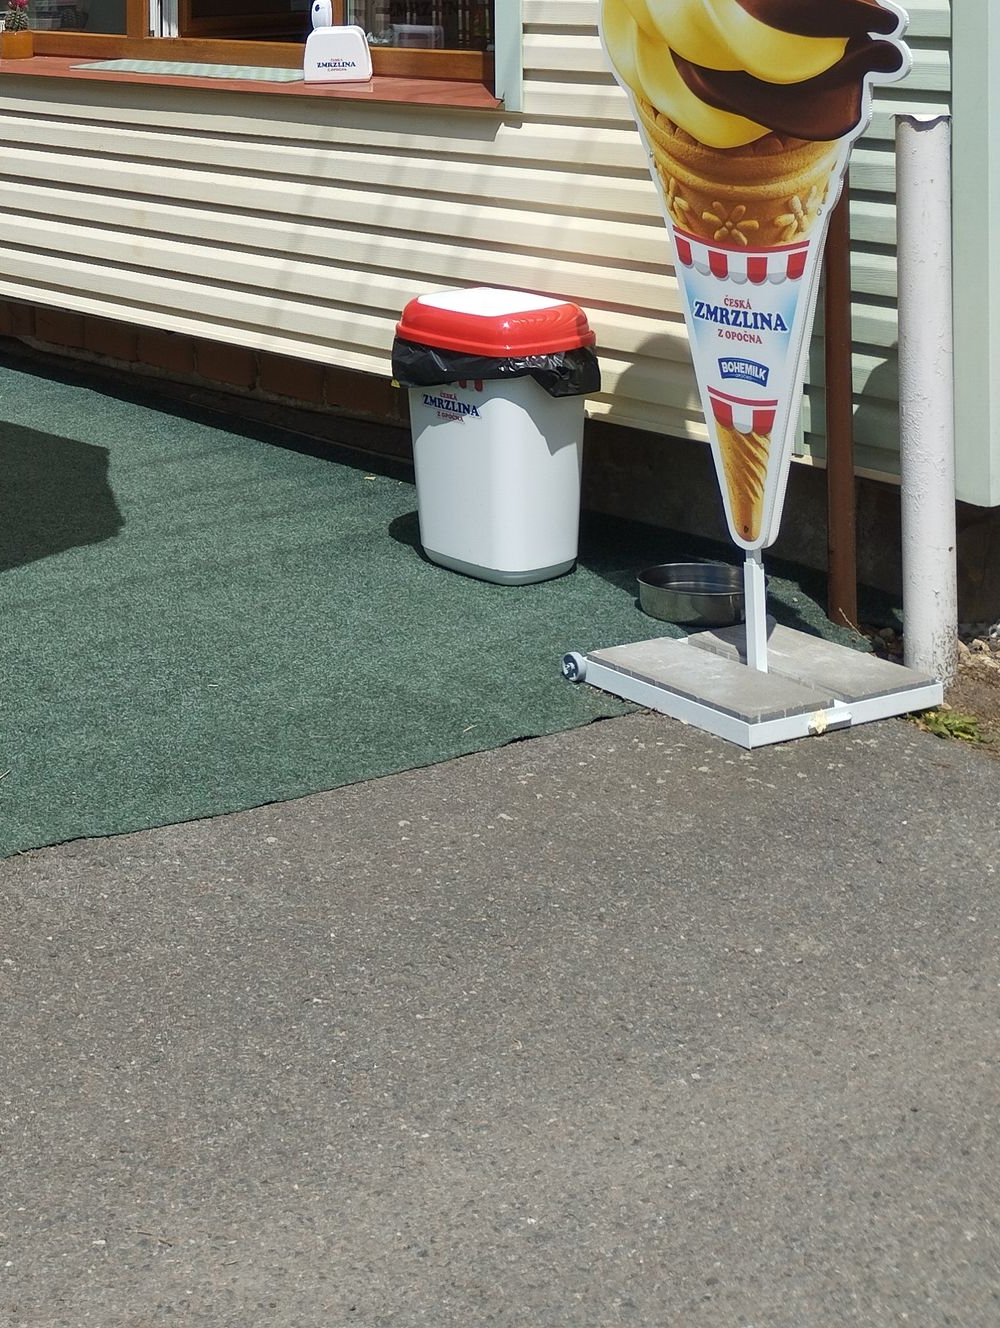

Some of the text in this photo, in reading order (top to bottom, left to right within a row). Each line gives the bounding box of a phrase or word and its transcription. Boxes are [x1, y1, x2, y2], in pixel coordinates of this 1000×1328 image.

[723, 294, 752, 310] ČESKÁ
[694, 301, 787, 332] ZMRZLINA
[718, 329, 762, 345] Z OPOČNA
[721, 361, 767, 381] BOHEMILK
[423, 394, 480, 417] ZMRZLINA
